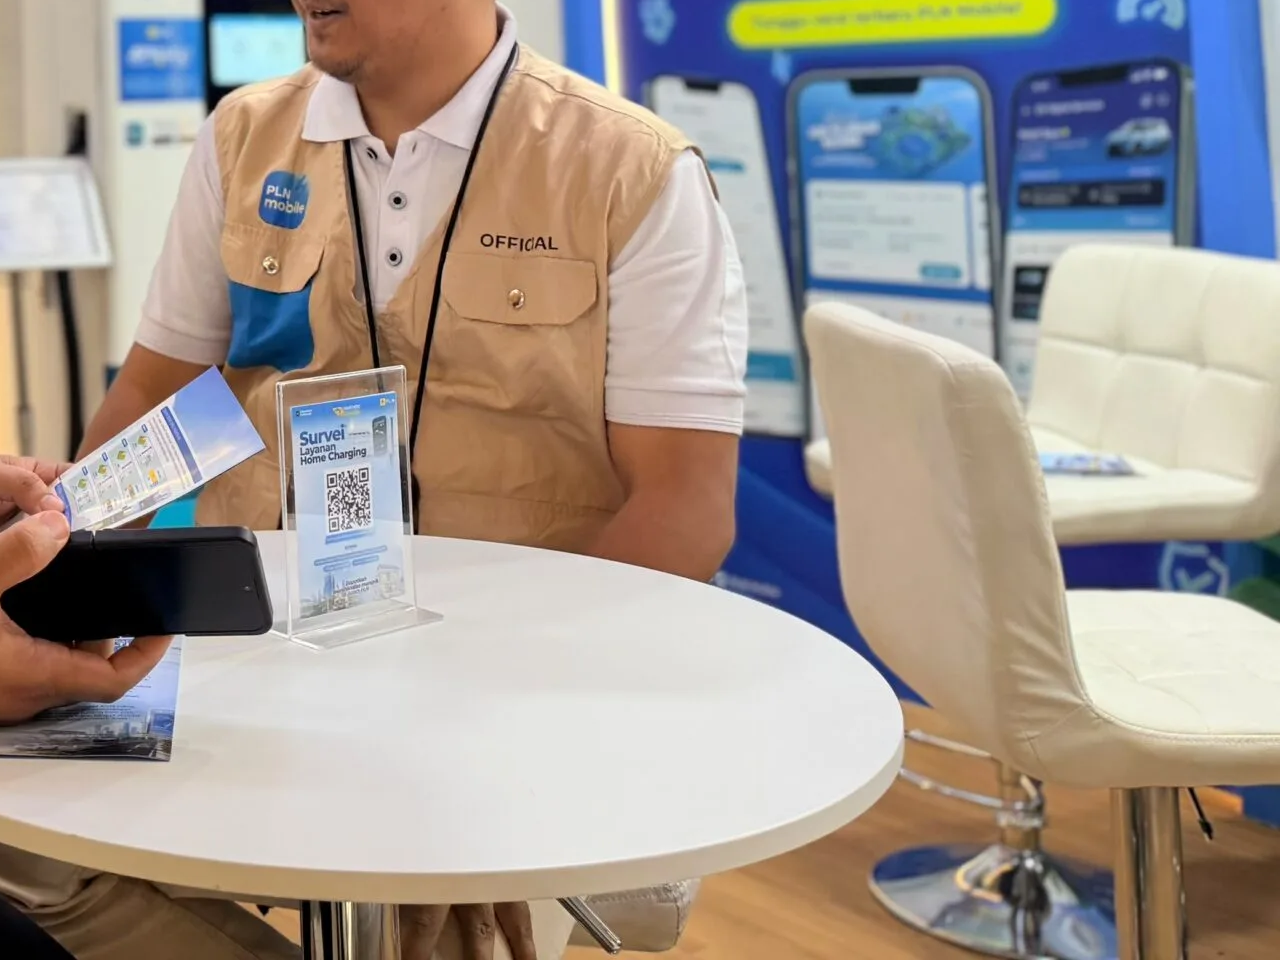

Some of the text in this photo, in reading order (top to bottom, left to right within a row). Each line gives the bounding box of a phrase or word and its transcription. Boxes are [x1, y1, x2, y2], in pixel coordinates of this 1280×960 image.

[266, 184, 291, 200] PLN
[264, 198, 305, 214] mobile
[299, 424, 345, 447] Survei
[300, 444, 336, 458] Layanan
[300, 447, 368, 466] Home Charging
